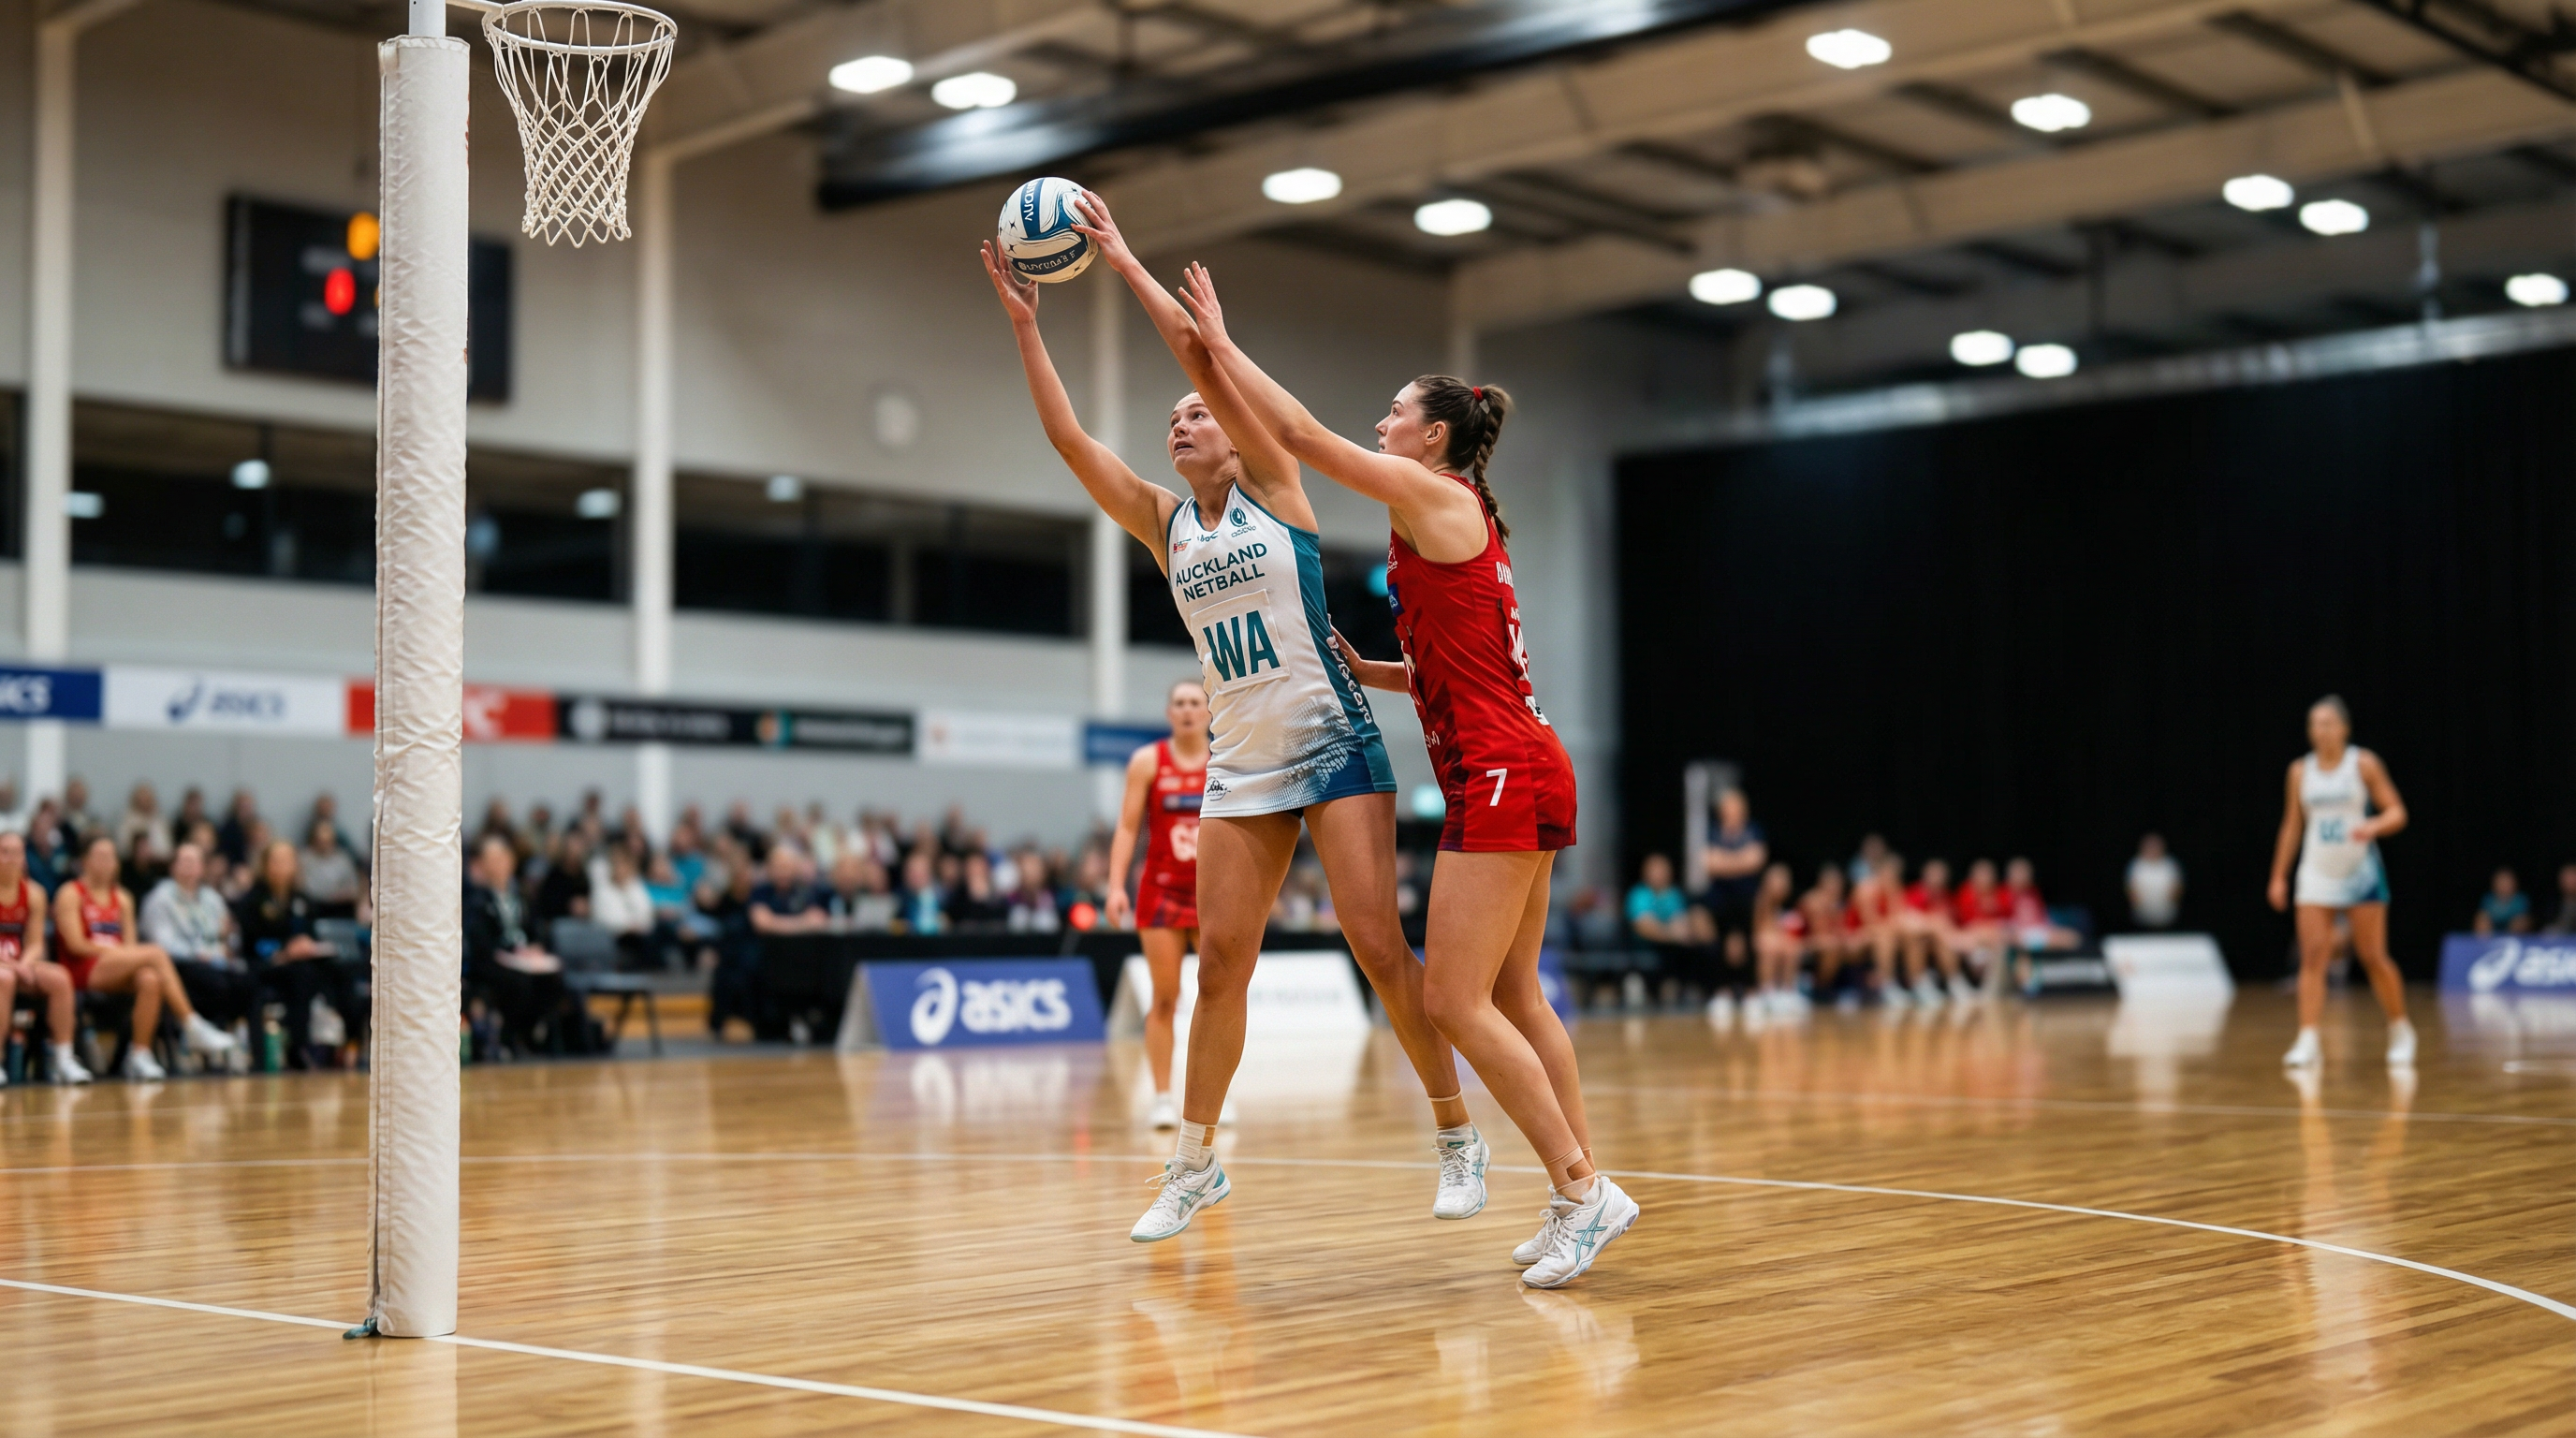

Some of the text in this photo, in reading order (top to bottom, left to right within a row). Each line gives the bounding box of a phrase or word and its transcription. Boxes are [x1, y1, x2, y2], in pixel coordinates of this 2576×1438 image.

[1176, 543, 1267, 587] AUCKLAND
[1183, 564, 1266, 602] NETBALL
[1203, 610, 1281, 682] WA
[1486, 769, 1508, 807] 7
[960, 979, 1073, 1033] asics
